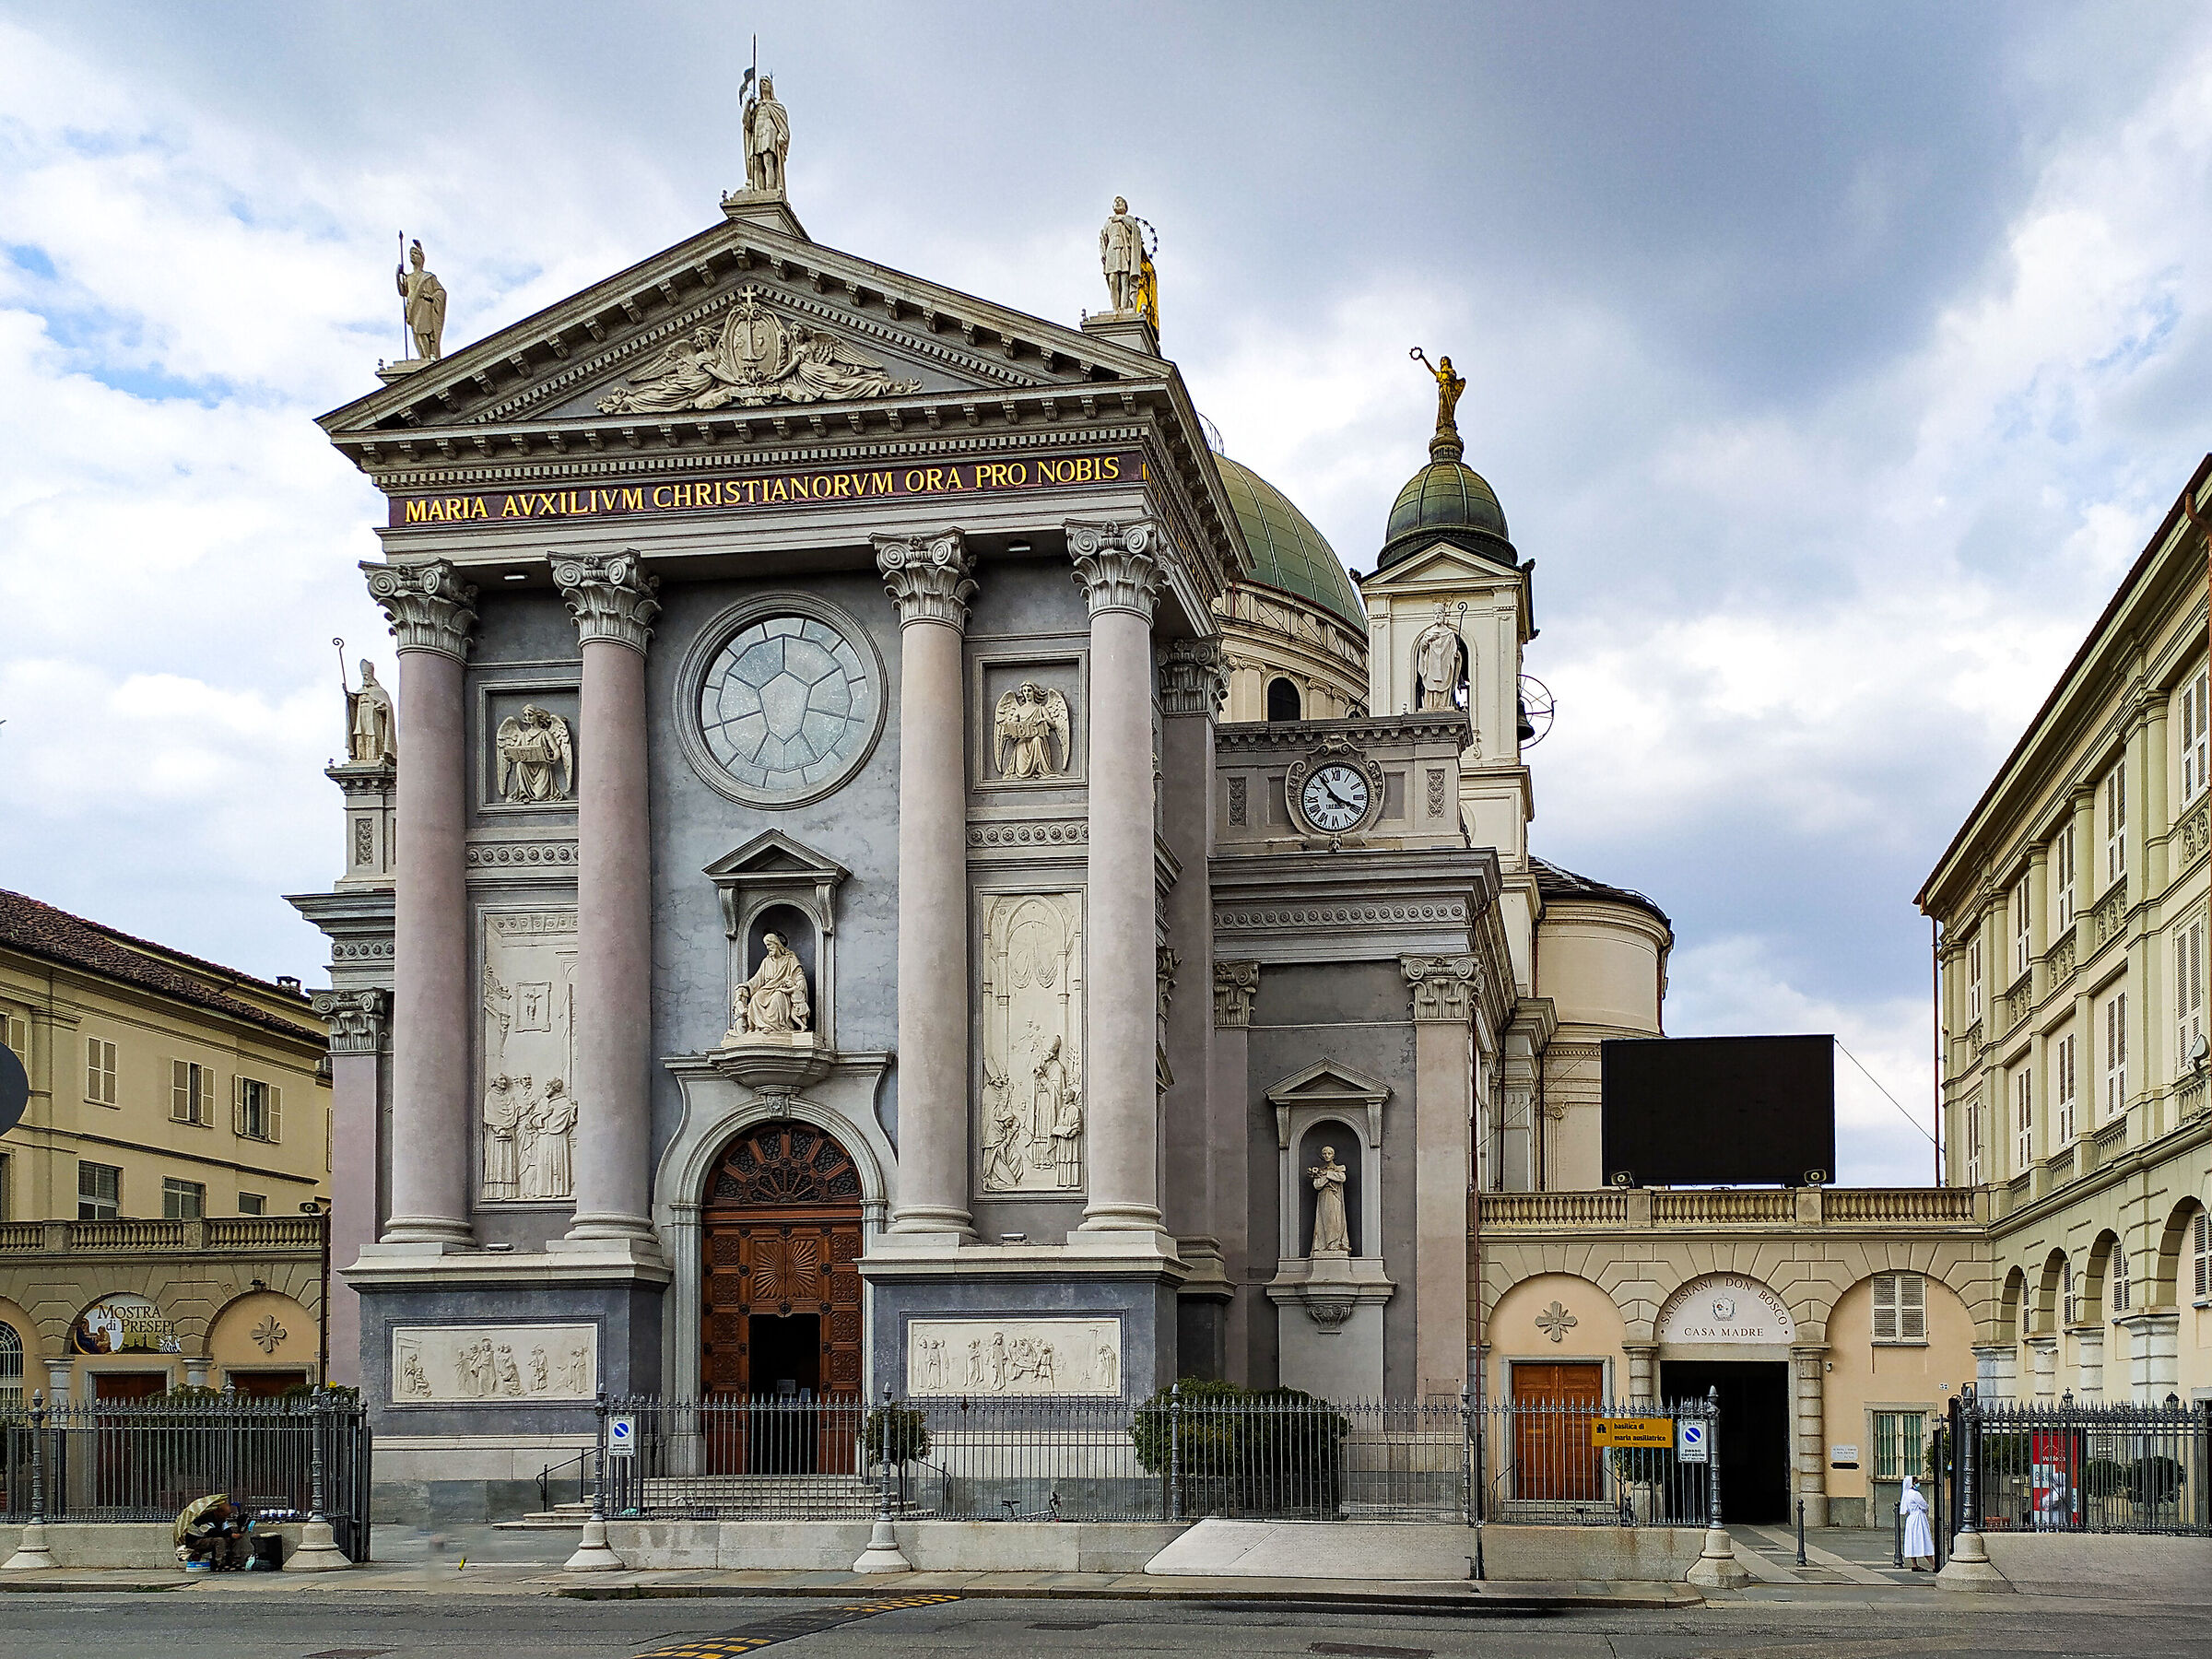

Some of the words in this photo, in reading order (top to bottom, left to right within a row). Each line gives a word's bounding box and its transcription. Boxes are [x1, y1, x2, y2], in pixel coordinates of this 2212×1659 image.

[406, 496, 488, 523] MARIA
[501, 488, 644, 518] AVXILIVM
[653, 471, 893, 508] CHRISTIANORVM
[905, 466, 963, 492] ORA
[975, 463, 1027, 488] PRO
[1037, 456, 1120, 484] NOBIS
[1661, 1278, 1712, 1324] SALESIANI
[1725, 1277, 1752, 1291] DON
[1759, 1290, 1788, 1325] BOSCO
[98, 1304, 162, 1319] MOSTRA
[106, 1319, 116, 1331] di
[121, 1319, 175, 1335] PRESEPI
[1684, 1327, 1716, 1336] CASA
[1721, 1327, 1764, 1336] MADRE
